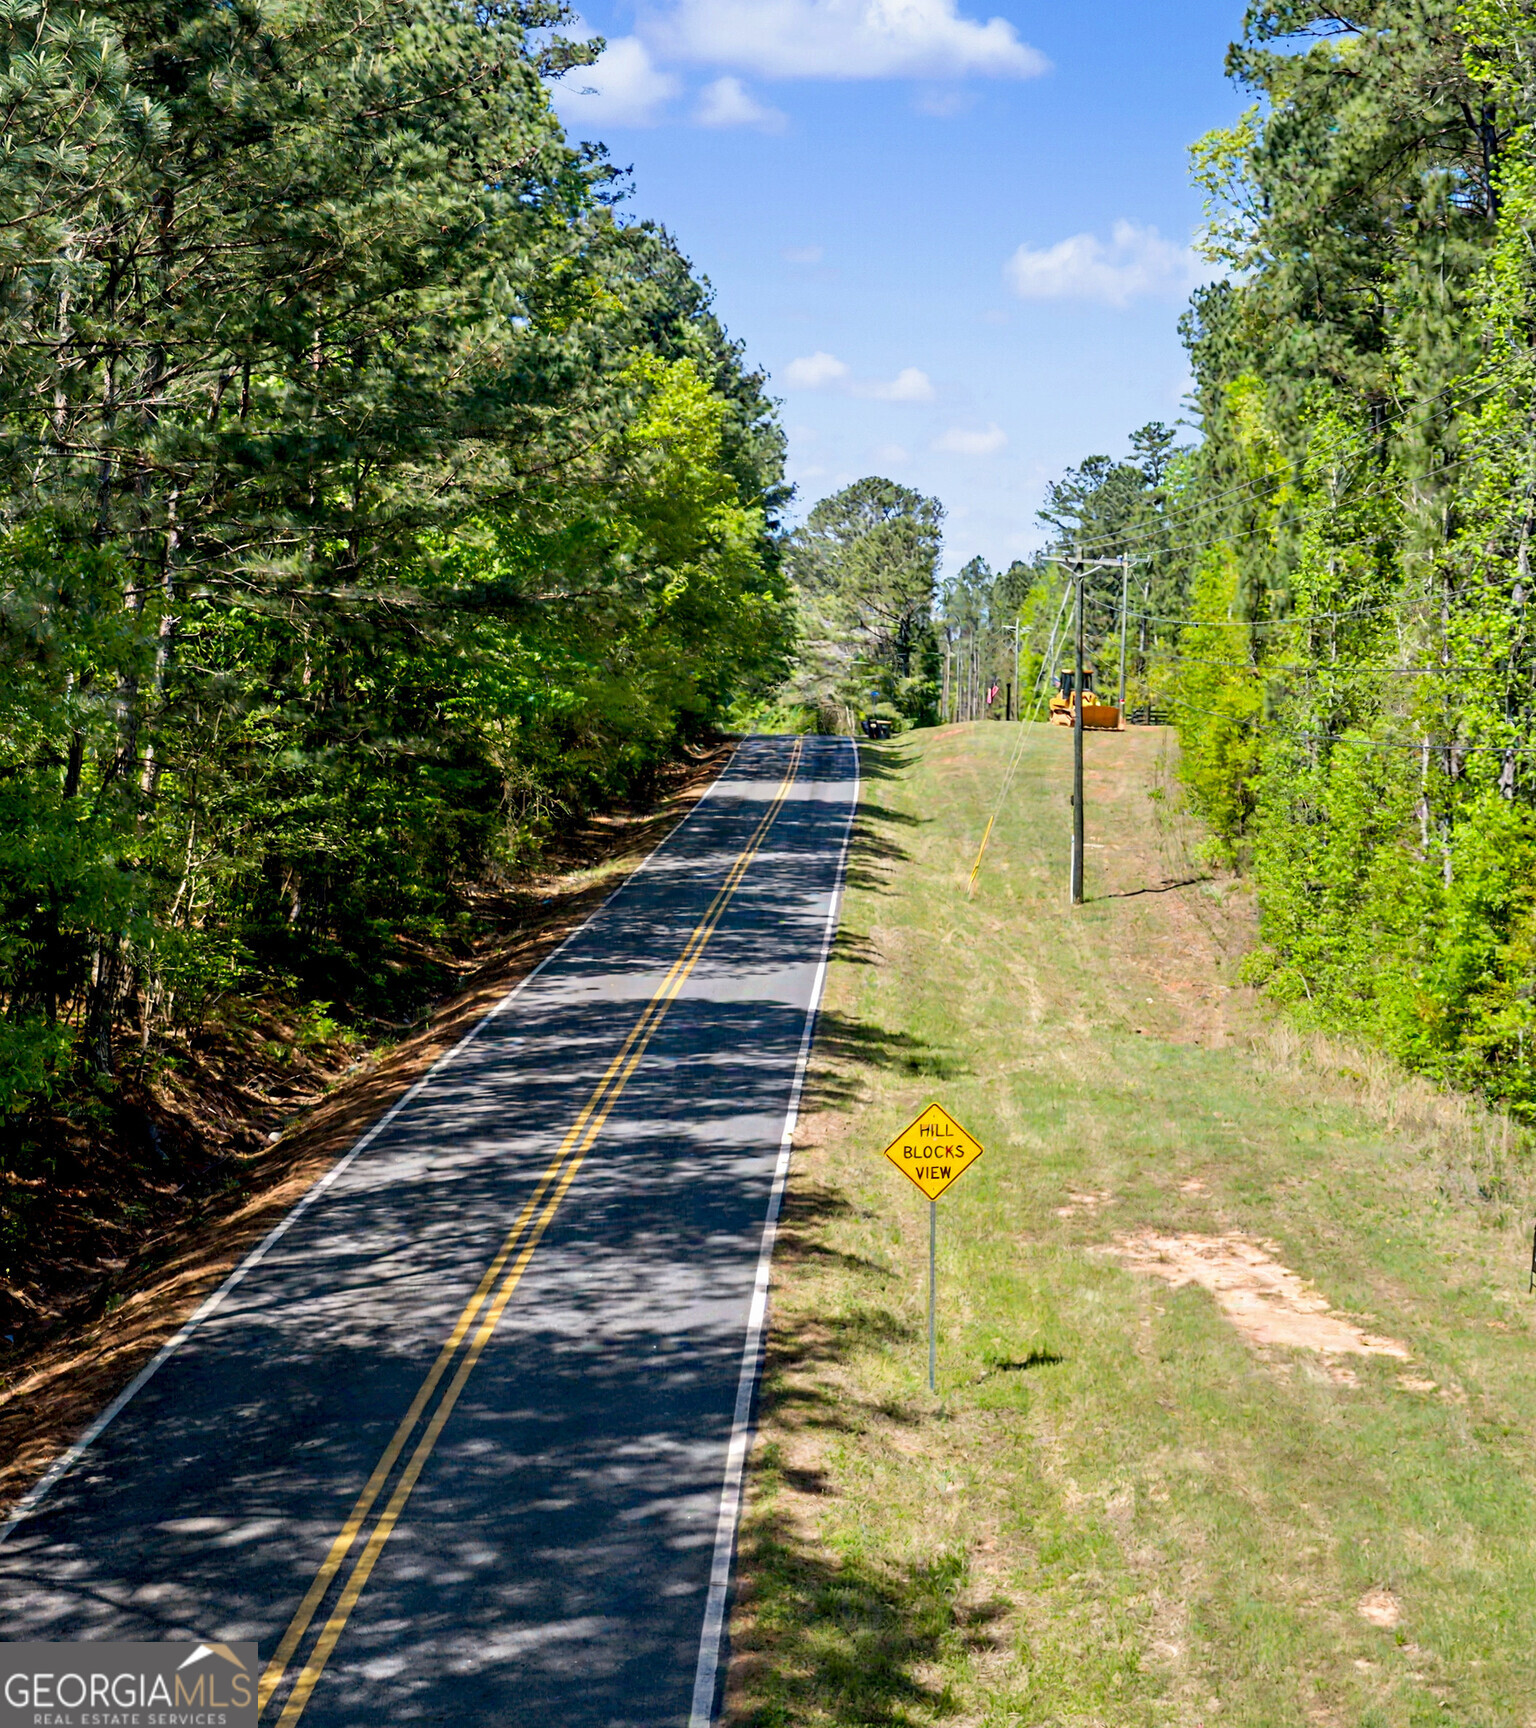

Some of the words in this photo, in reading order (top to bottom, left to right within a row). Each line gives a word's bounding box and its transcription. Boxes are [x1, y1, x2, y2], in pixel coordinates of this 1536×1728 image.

[920, 1124, 954, 1137] HILL
[903, 1145, 965, 1159] BLOCKS
[915, 1166, 952, 1180] VIEW
